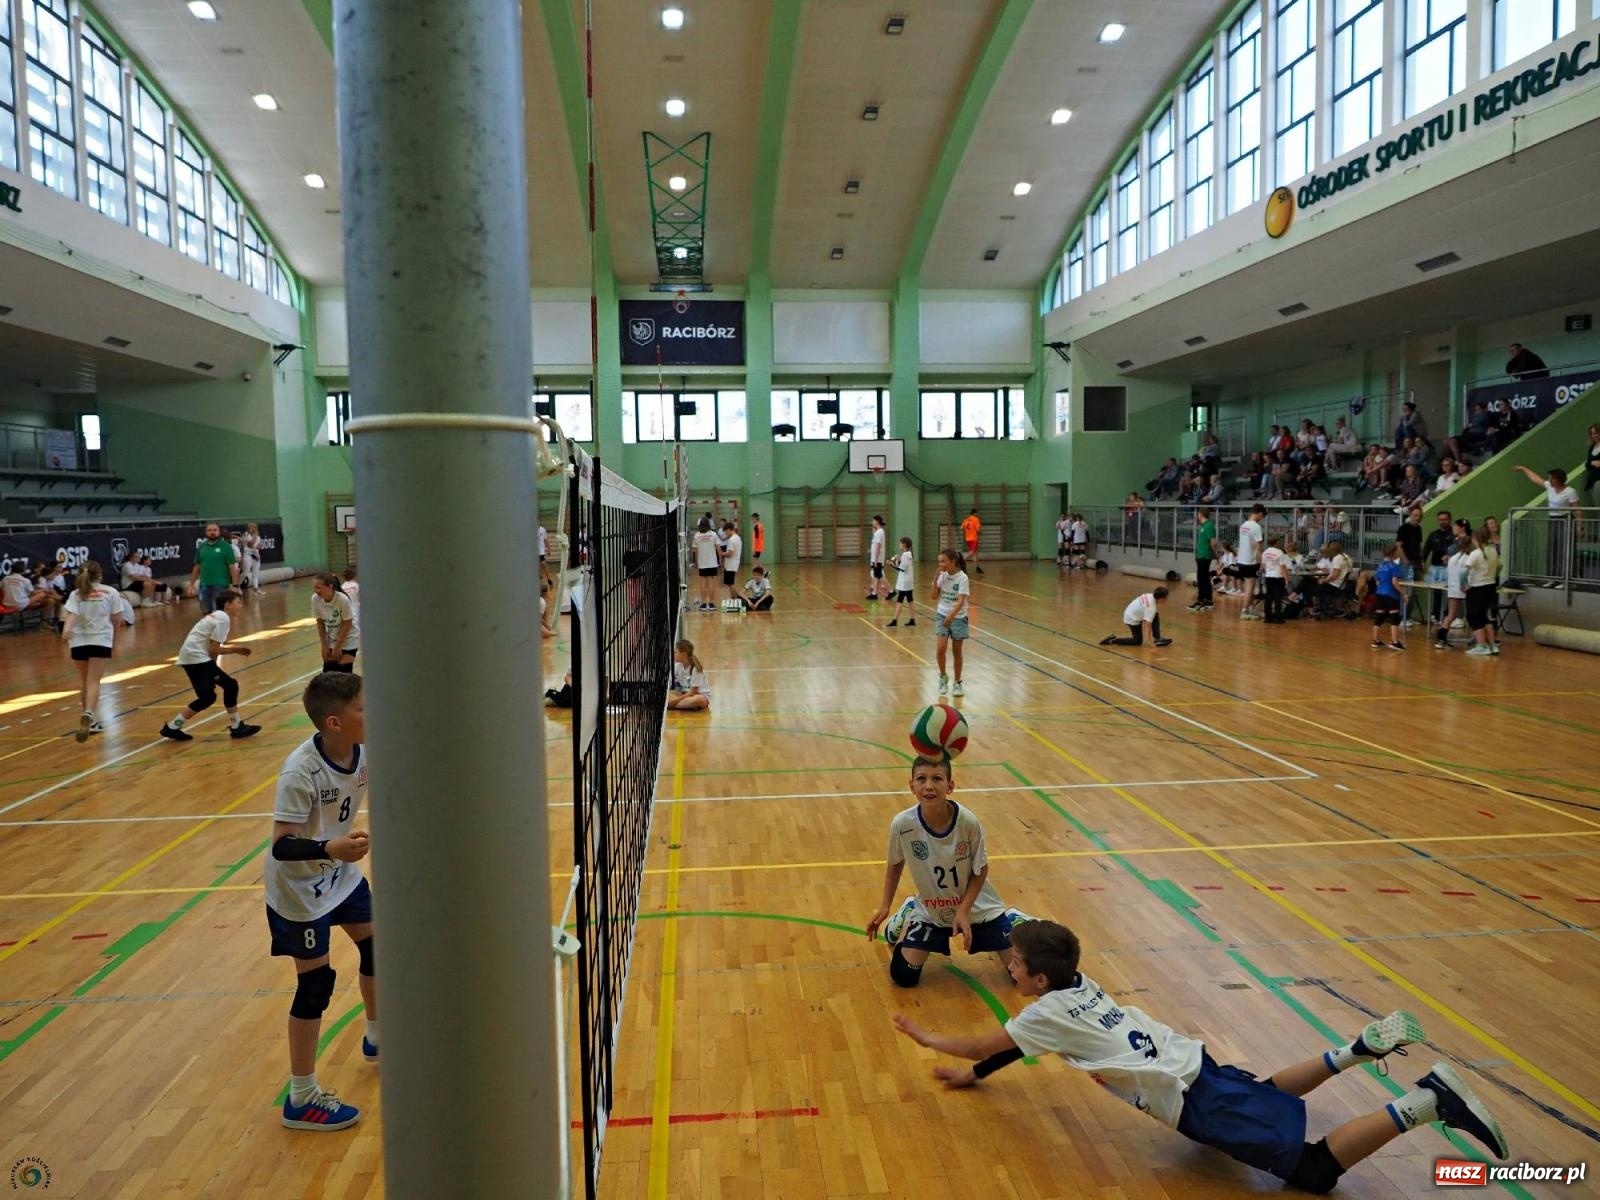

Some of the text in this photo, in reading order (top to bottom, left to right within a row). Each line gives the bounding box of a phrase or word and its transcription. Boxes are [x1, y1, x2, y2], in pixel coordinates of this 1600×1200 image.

[1297, 153, 1370, 209] OŚRODEK
[1375, 110, 1453, 172] SPORTU
[1459, 103, 1467, 132] I
[662, 323, 736, 339] RACIBÓRZ
[338, 795, 351, 823] 8
[933, 865, 959, 889] 21
[304, 928, 316, 949] 8
[906, 920, 933, 942] 21
